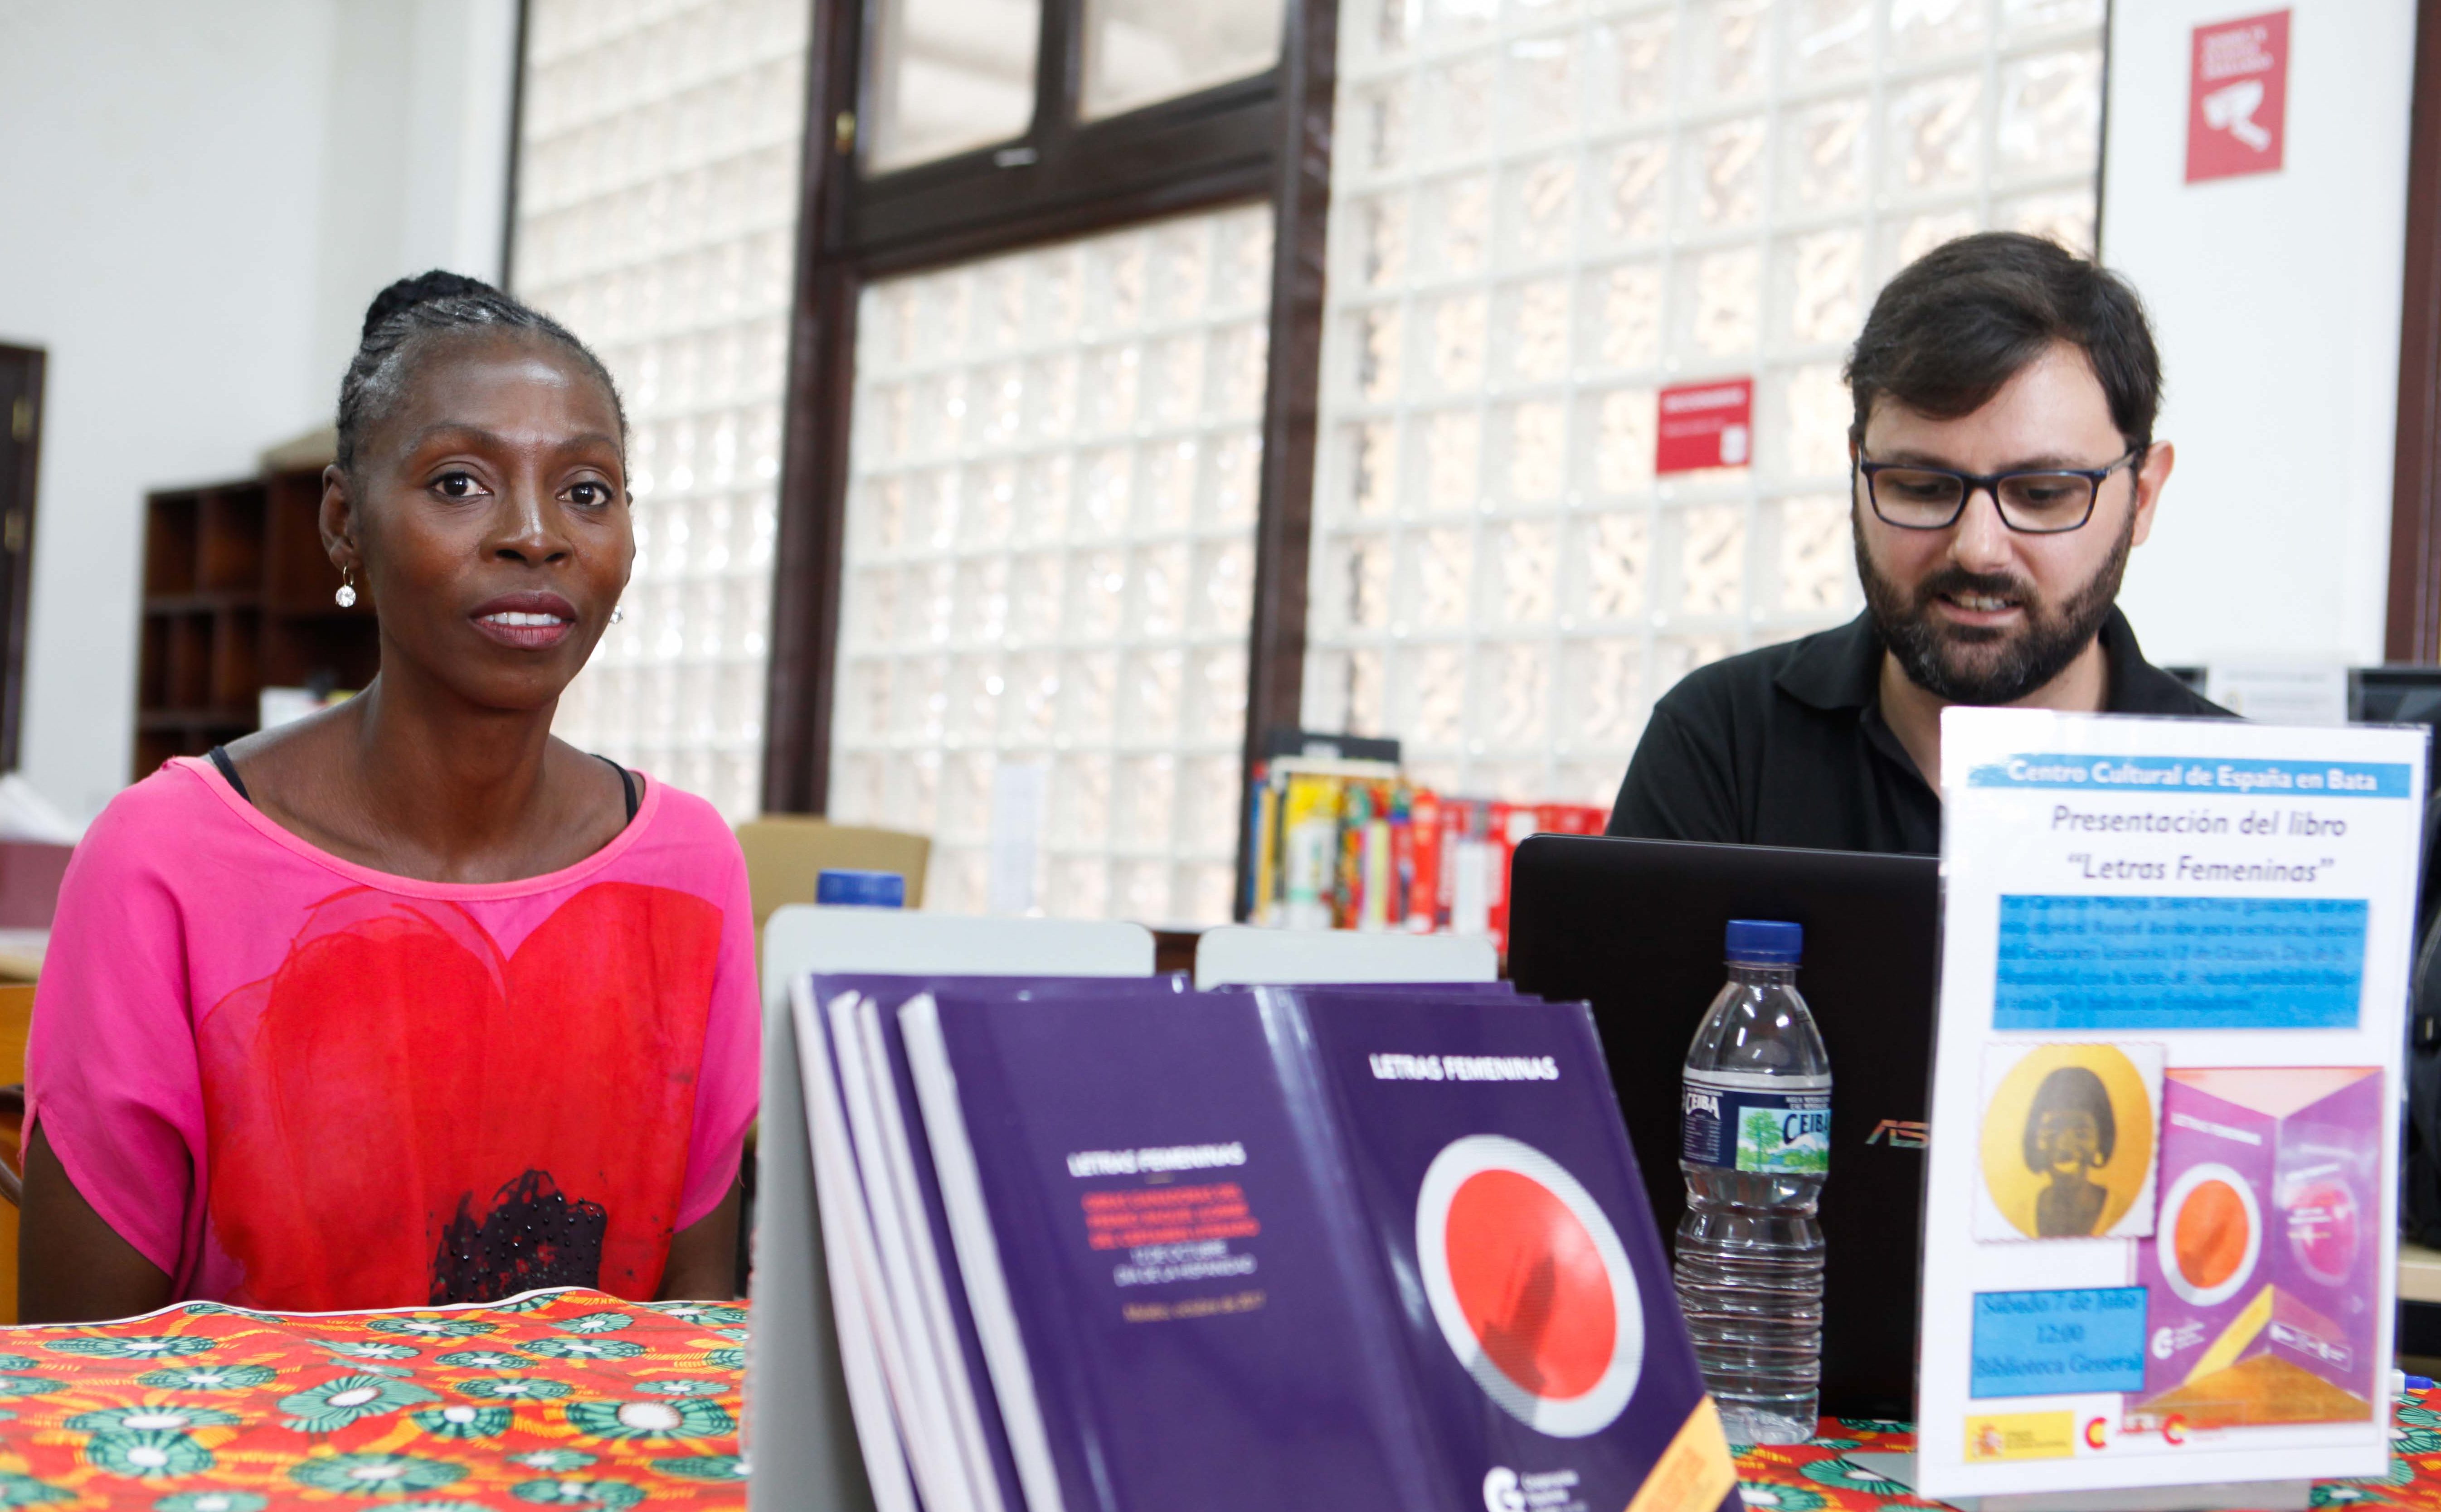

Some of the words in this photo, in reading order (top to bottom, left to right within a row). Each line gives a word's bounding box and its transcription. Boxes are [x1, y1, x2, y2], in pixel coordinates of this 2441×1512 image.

[2007, 759, 2087, 783] Centro
[2091, 761, 2183, 785] Cultural
[2185, 765, 2214, 786] de
[2217, 765, 2293, 793] España
[2295, 773, 2324, 789] en
[2327, 768, 2378, 791] Bata
[2052, 804, 2228, 833] Presentación
[2238, 810, 2279, 834] del
[2288, 811, 2346, 836] libro
[1369, 1053, 1444, 1081] LETRAS
[1442, 1056, 1559, 1081] FEMENINAS
[1686, 1093, 1721, 1120] CEIBA
[1066, 1149, 1138, 1177] LETRAS
[1137, 1141, 1246, 1173] FEMENINAS
